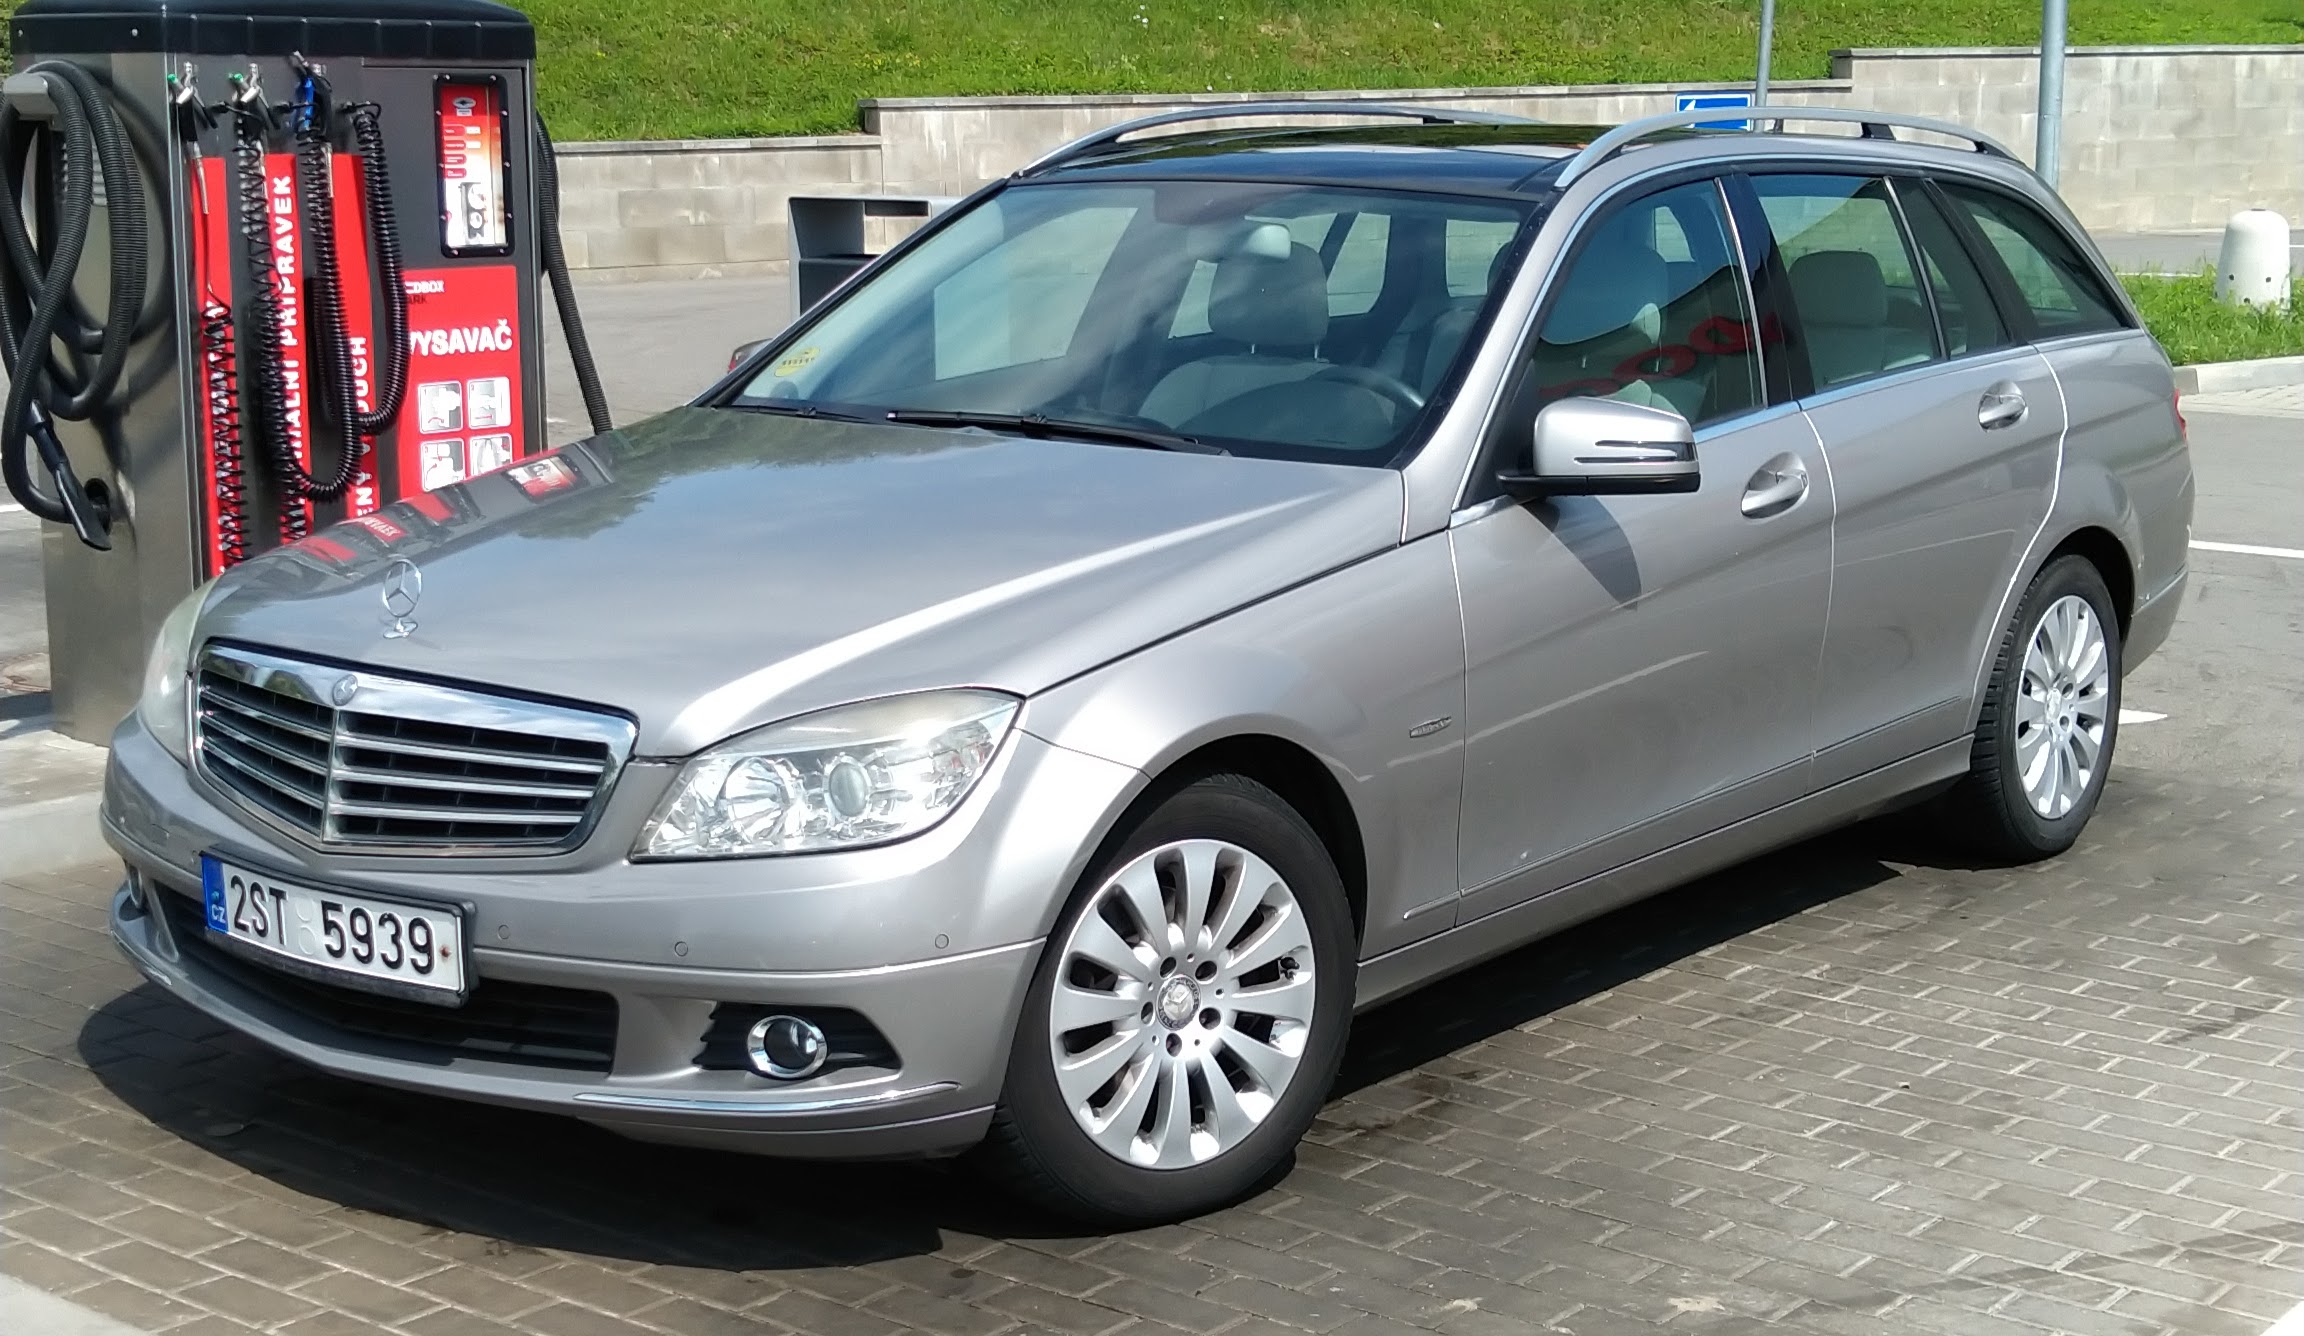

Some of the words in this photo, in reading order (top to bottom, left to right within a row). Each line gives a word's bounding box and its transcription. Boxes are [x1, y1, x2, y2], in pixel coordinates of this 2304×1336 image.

[211, 903, 227, 923] CZ
[231, 875, 288, 945] 2ST
[321, 900, 437, 975] 5939
